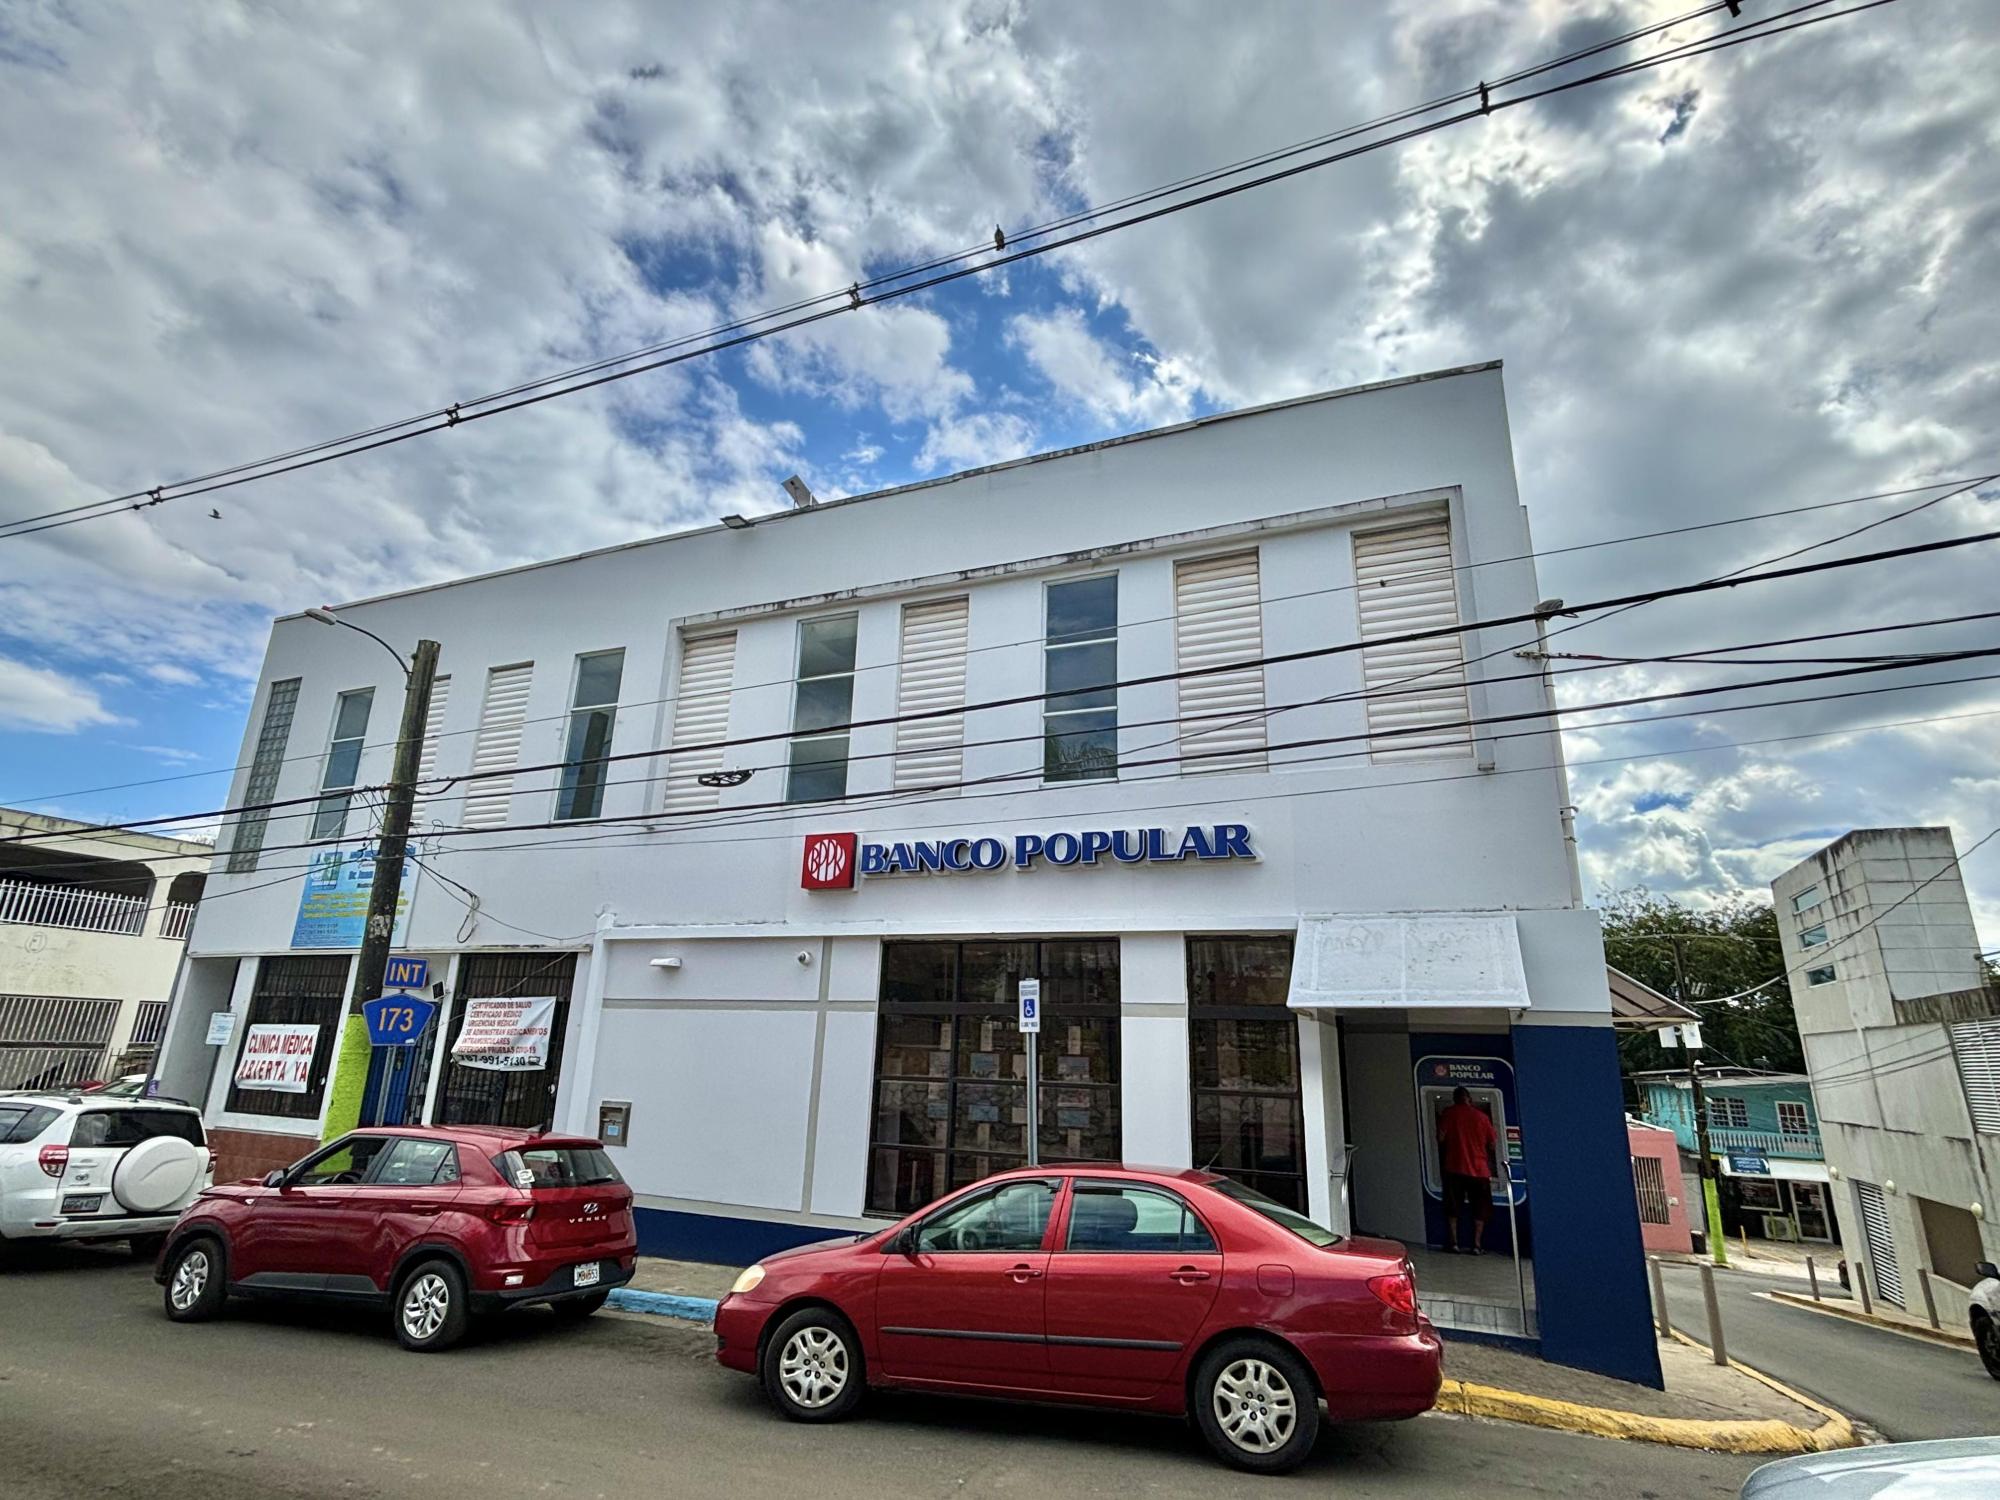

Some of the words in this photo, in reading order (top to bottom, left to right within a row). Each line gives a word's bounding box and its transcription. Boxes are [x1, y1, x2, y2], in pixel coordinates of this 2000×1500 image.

[861, 838, 1007, 874] BANCO
[1014, 824, 1258, 866] POPULAR
[389, 963, 422, 983] INT
[508, 1001, 515, 1009] DE
[516, 1001, 532, 1009] SALUD
[379, 1007, 414, 1032] 173
[248, 1034, 280, 1054] CLINICA
[237, 1060, 287, 1080] ABIERTA
[294, 1061, 308, 1082] YA
[1450, 1072, 1494, 1080] POPULAR
